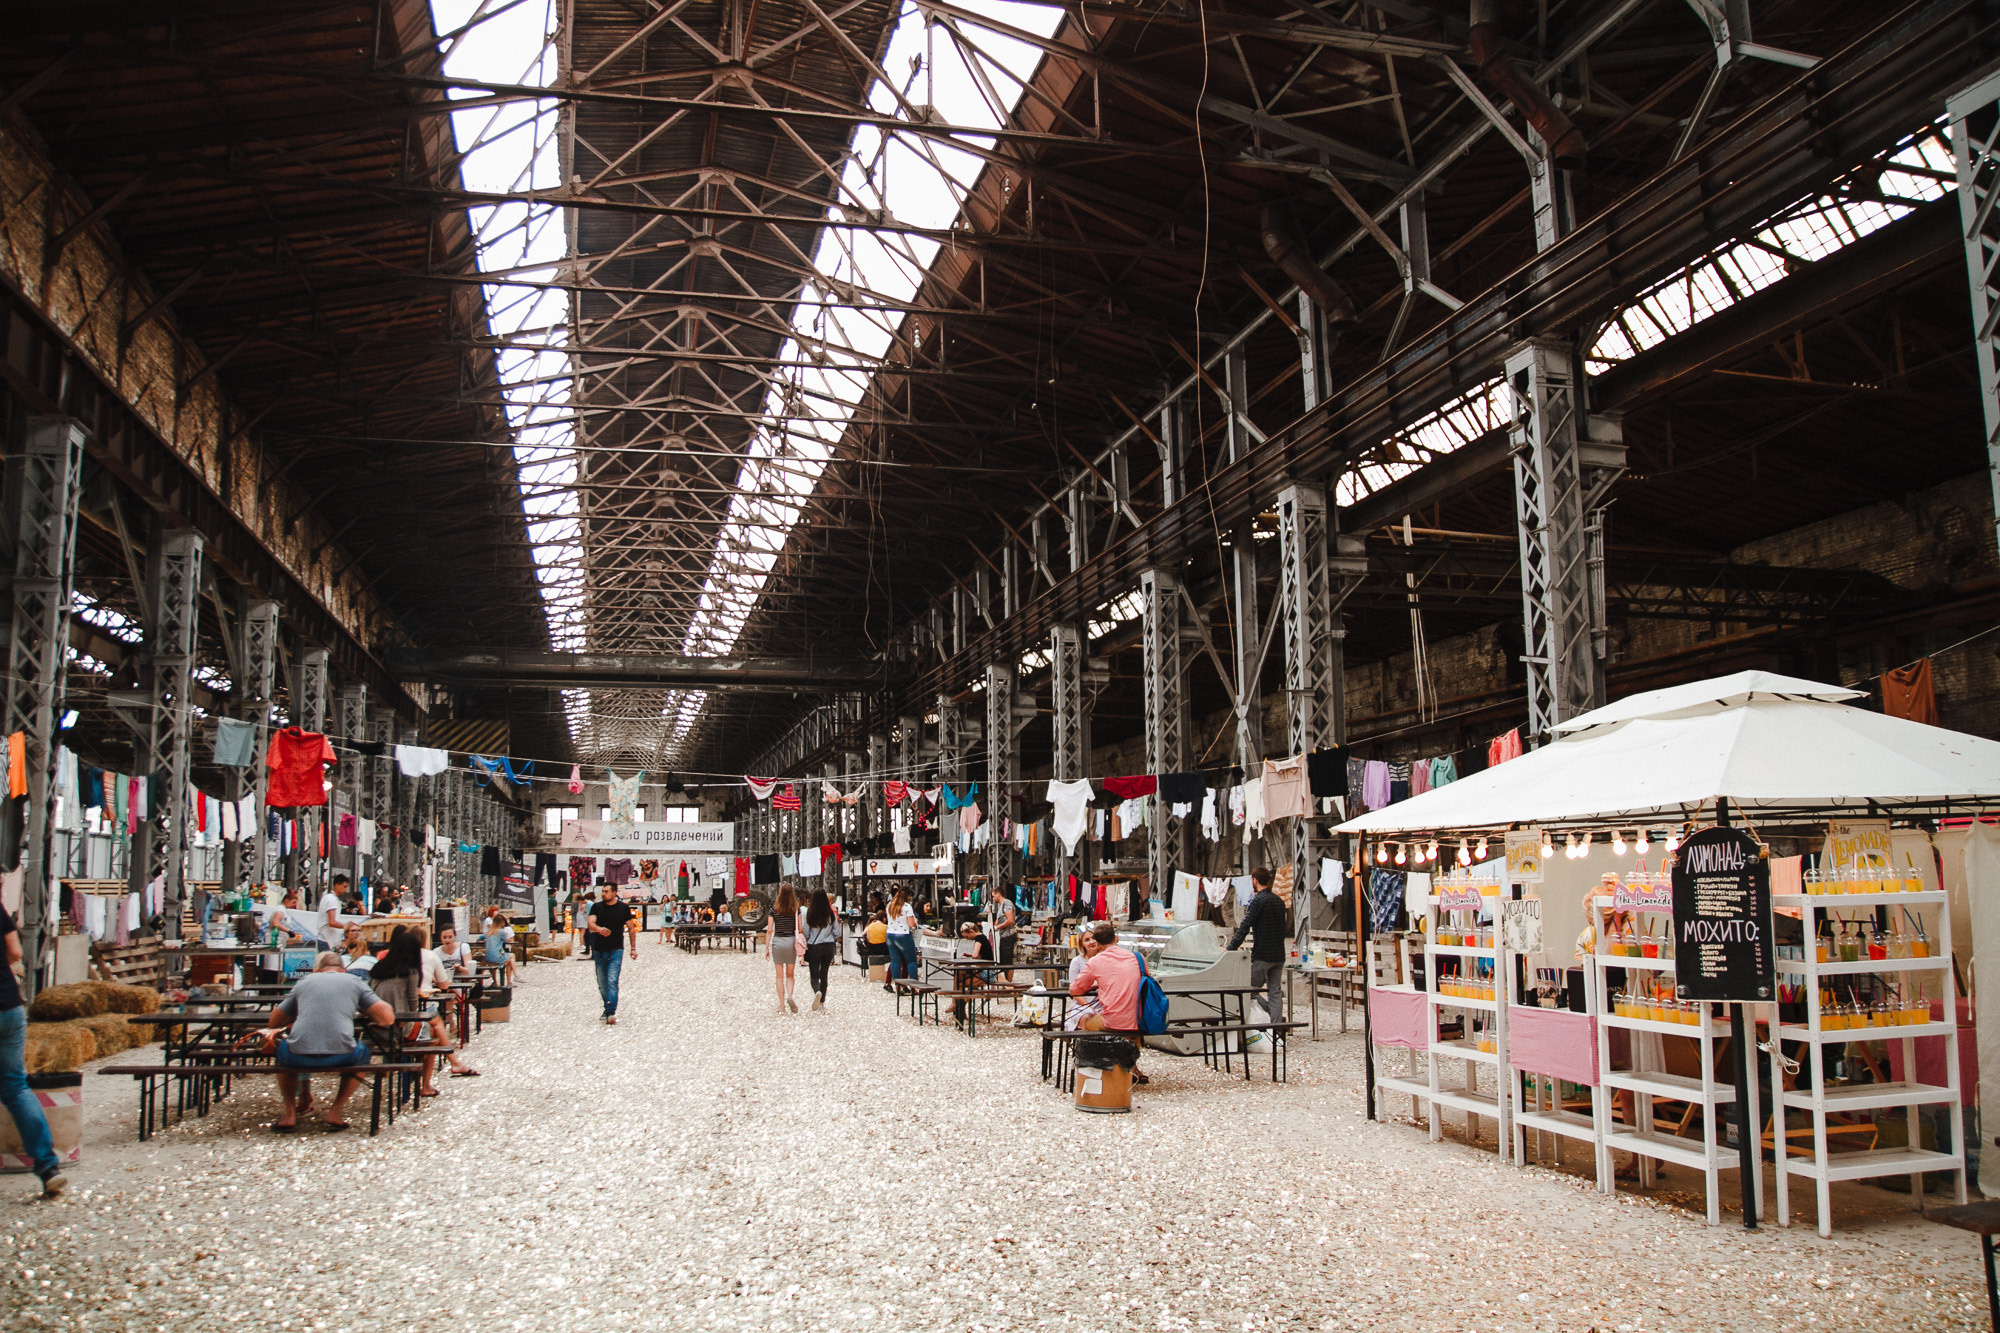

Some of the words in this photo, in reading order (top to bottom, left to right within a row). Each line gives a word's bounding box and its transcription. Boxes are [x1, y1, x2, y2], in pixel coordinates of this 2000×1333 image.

[646, 830, 723, 844] развлечений
[1840, 826, 1850, 834] the
[1685, 841, 1746, 874] ЛИМОНАД:
[1504, 900, 1540, 921] МОХИТО
[1684, 920, 1760, 942] МОХИТО:
